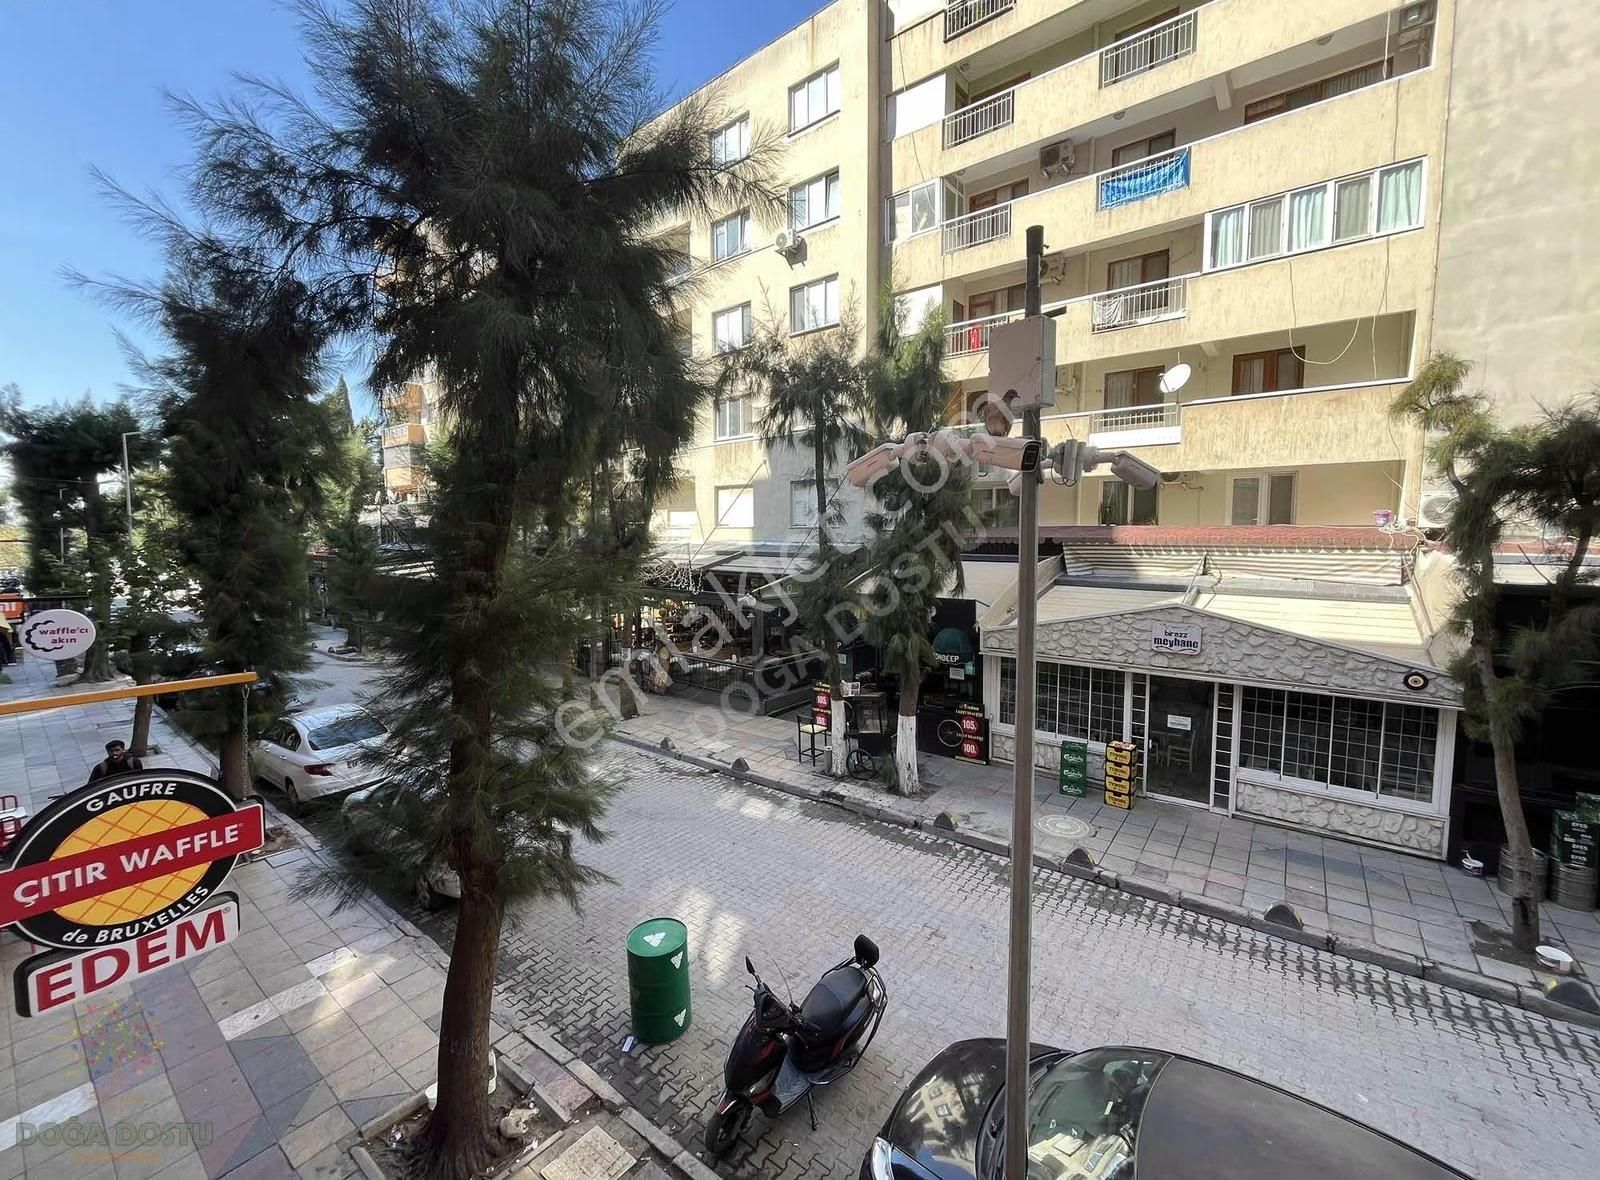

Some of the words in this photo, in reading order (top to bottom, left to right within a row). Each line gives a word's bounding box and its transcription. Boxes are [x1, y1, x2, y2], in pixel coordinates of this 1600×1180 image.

[1153, 637, 1199, 649] meyhane
[85, 783, 177, 812] GAUFRE
[13, 861, 106, 907] ÇITIR
[119, 824, 240, 873] WAFFLE
[62, 928, 88, 944] de
[94, 885, 210, 944] BRUXELLES
[36, 909, 226, 1013] EDEM
